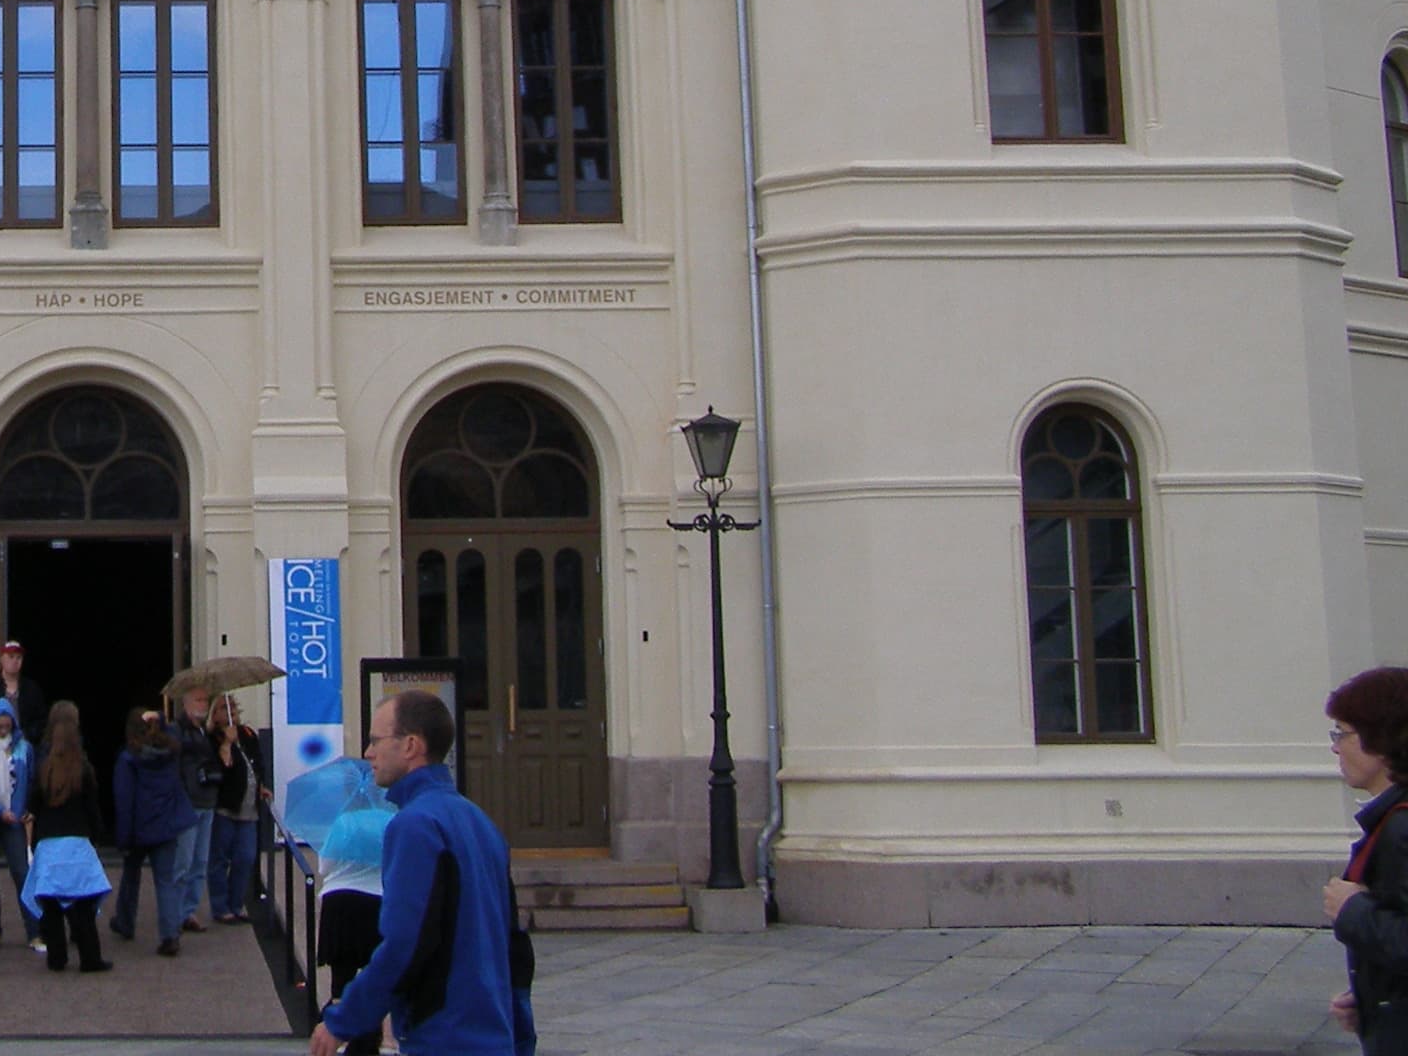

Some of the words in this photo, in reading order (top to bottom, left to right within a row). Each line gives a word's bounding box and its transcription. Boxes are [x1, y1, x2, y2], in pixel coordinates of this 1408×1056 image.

[93, 293, 145, 308] HOPE
[363, 291, 494, 306] ENGASJEMENT
[515, 289, 637, 305] COMMITMENT
[289, 621, 301, 679] TOPIC
